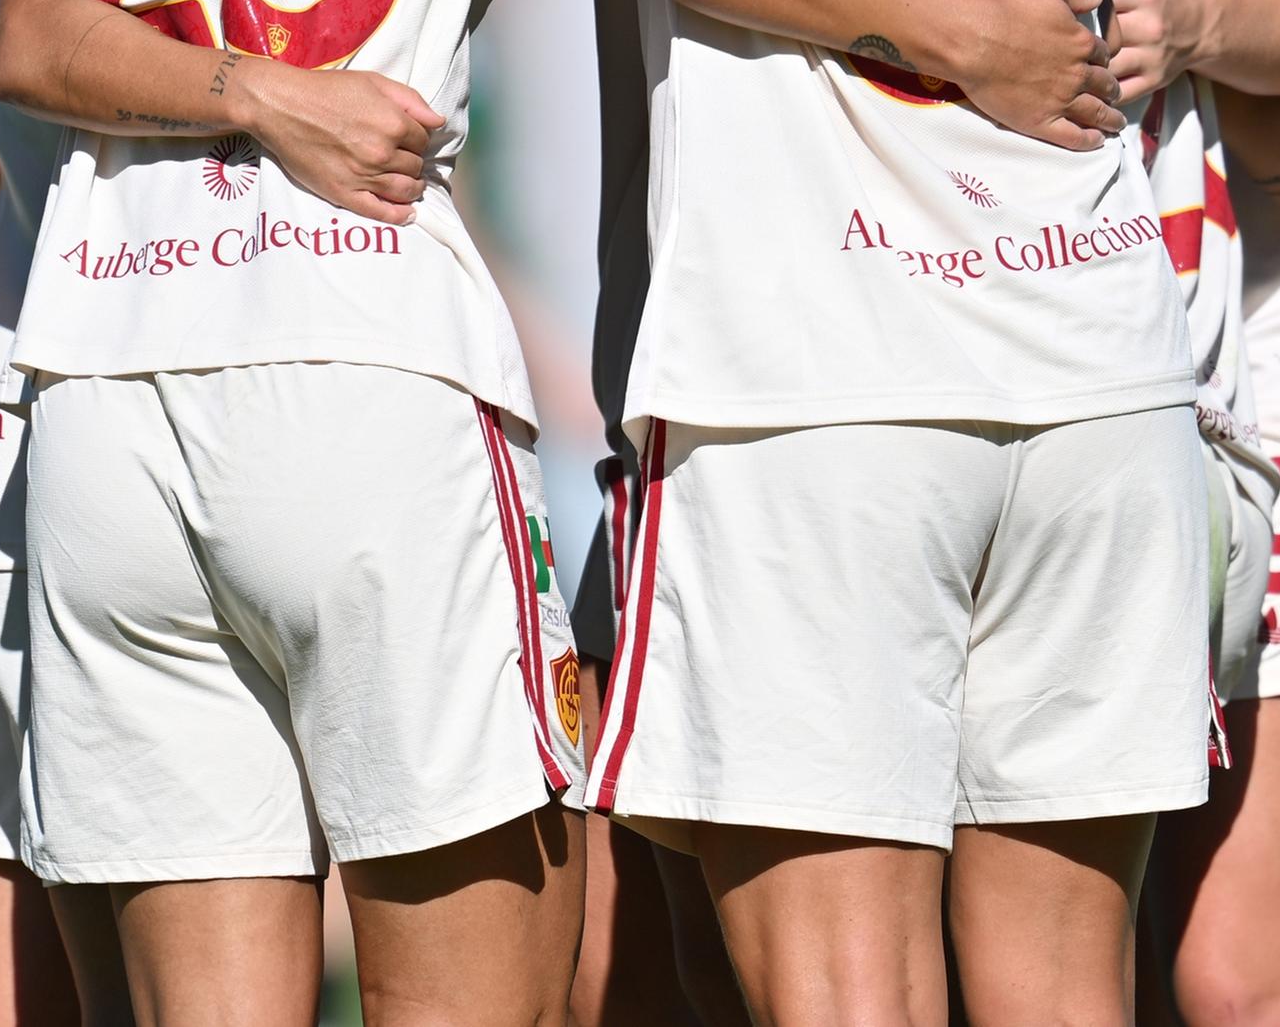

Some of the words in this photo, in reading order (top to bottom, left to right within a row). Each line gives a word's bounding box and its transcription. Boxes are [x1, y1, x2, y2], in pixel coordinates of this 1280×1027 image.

[59, 238, 200, 282] Auberge
[211, 211, 403, 268] Collection
[840, 208, 986, 289] Auerge
[994, 213, 1163, 273] Collection
